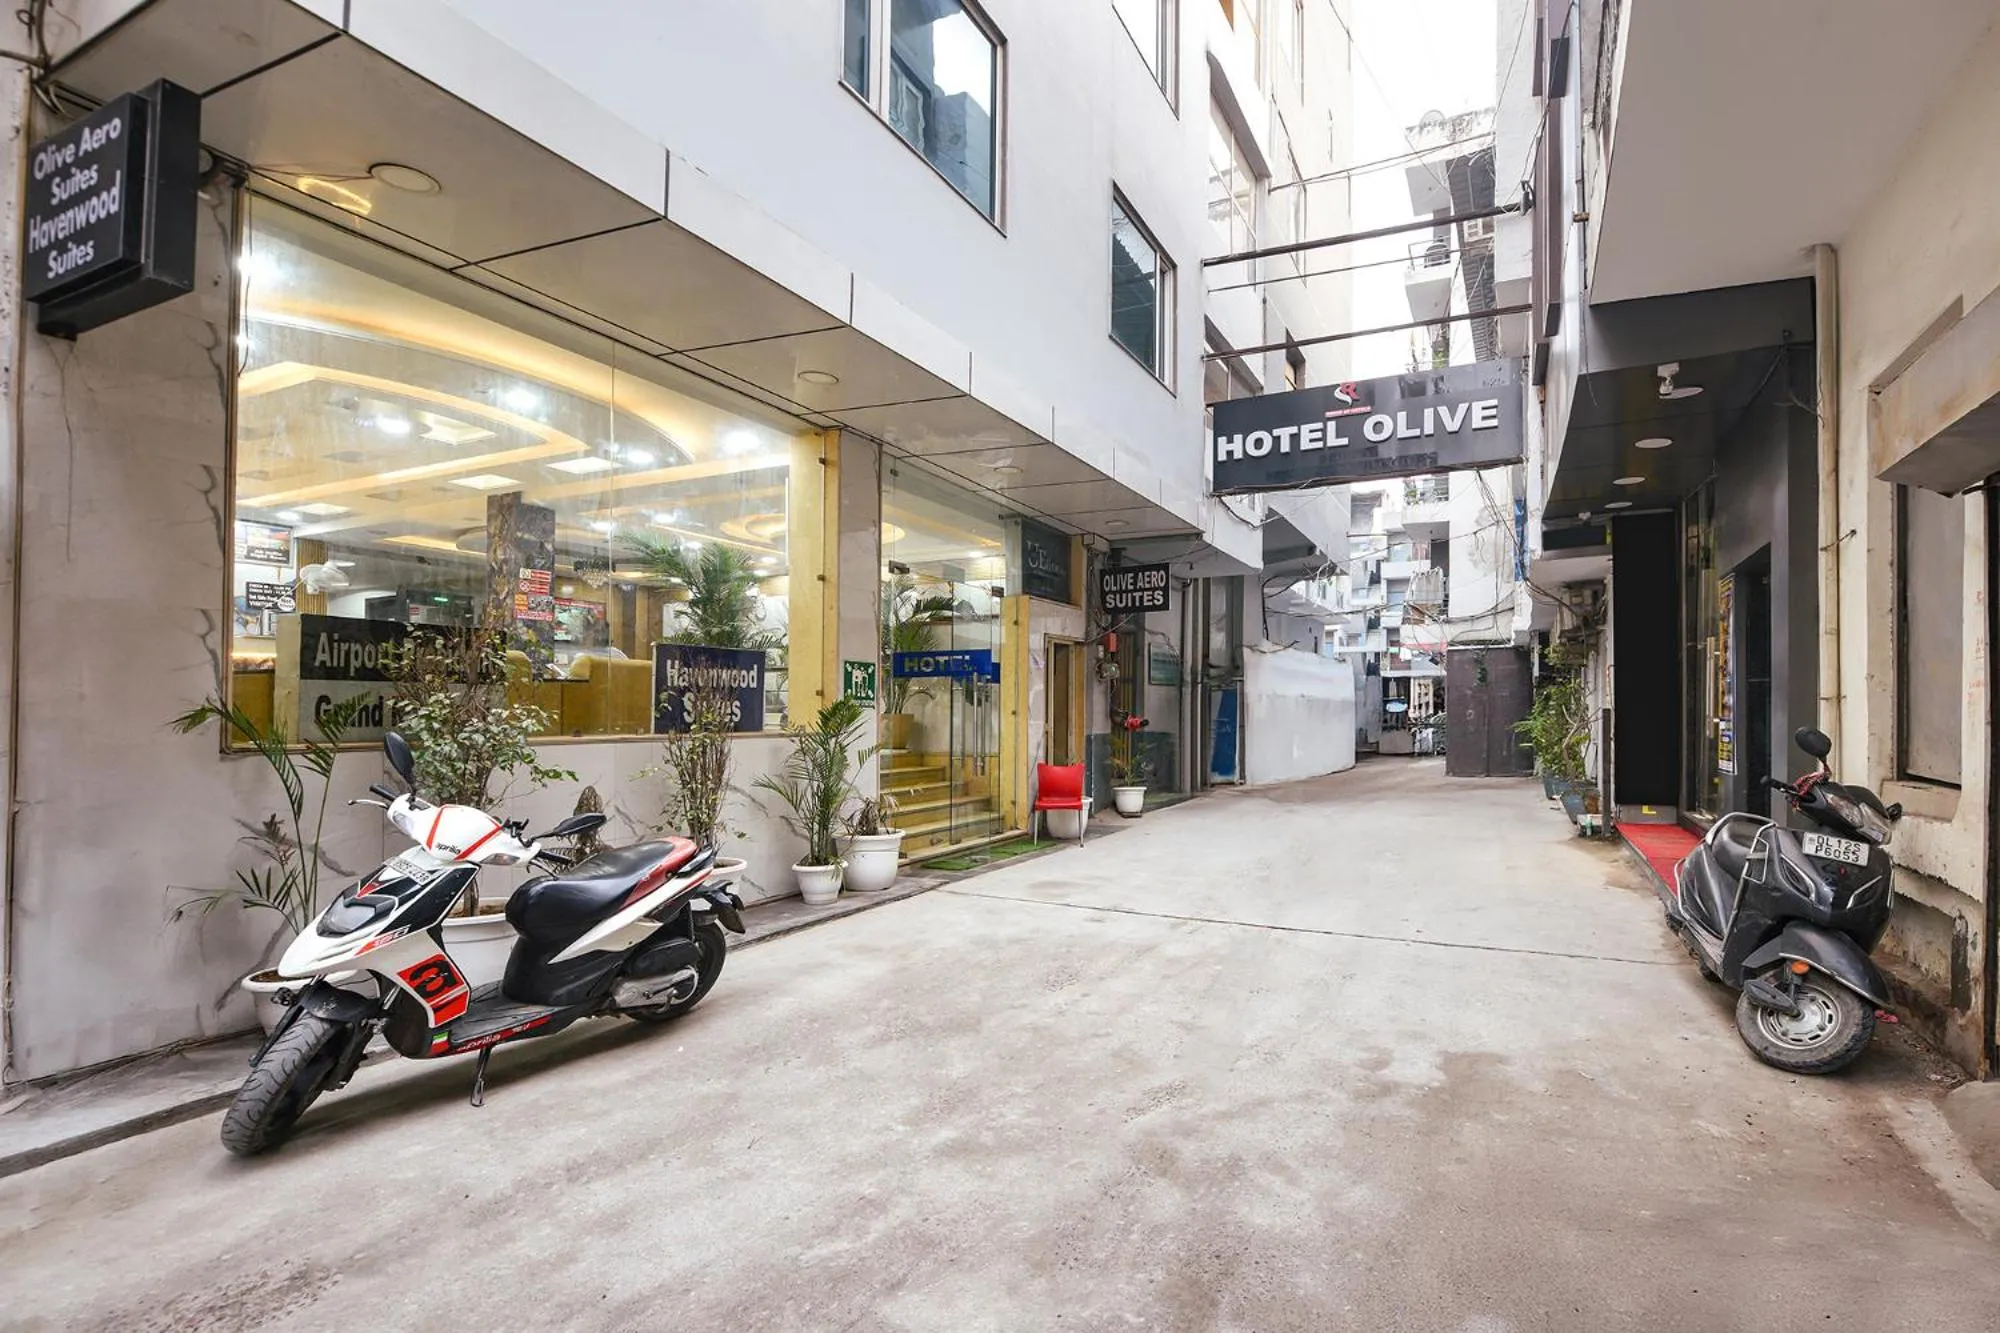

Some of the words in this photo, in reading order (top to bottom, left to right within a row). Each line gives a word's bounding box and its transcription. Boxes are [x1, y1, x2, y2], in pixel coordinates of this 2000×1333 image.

[34, 143, 75, 180] Olive
[79, 117, 121, 157] Aero
[51, 164, 98, 205] Suites
[29, 170, 121, 253] Havenwood
[47, 239, 95, 279] Suites
[1216, 421, 1349, 462] HOTEL
[1363, 399, 1499, 442] OLIVE
[1103, 573, 1134, 592] OLIVE
[1136, 570, 1166, 590] AERO
[1105, 590, 1164, 609] SUITES
[314, 632, 394, 676] Airpor
[314, 694, 384, 728] Gnd
